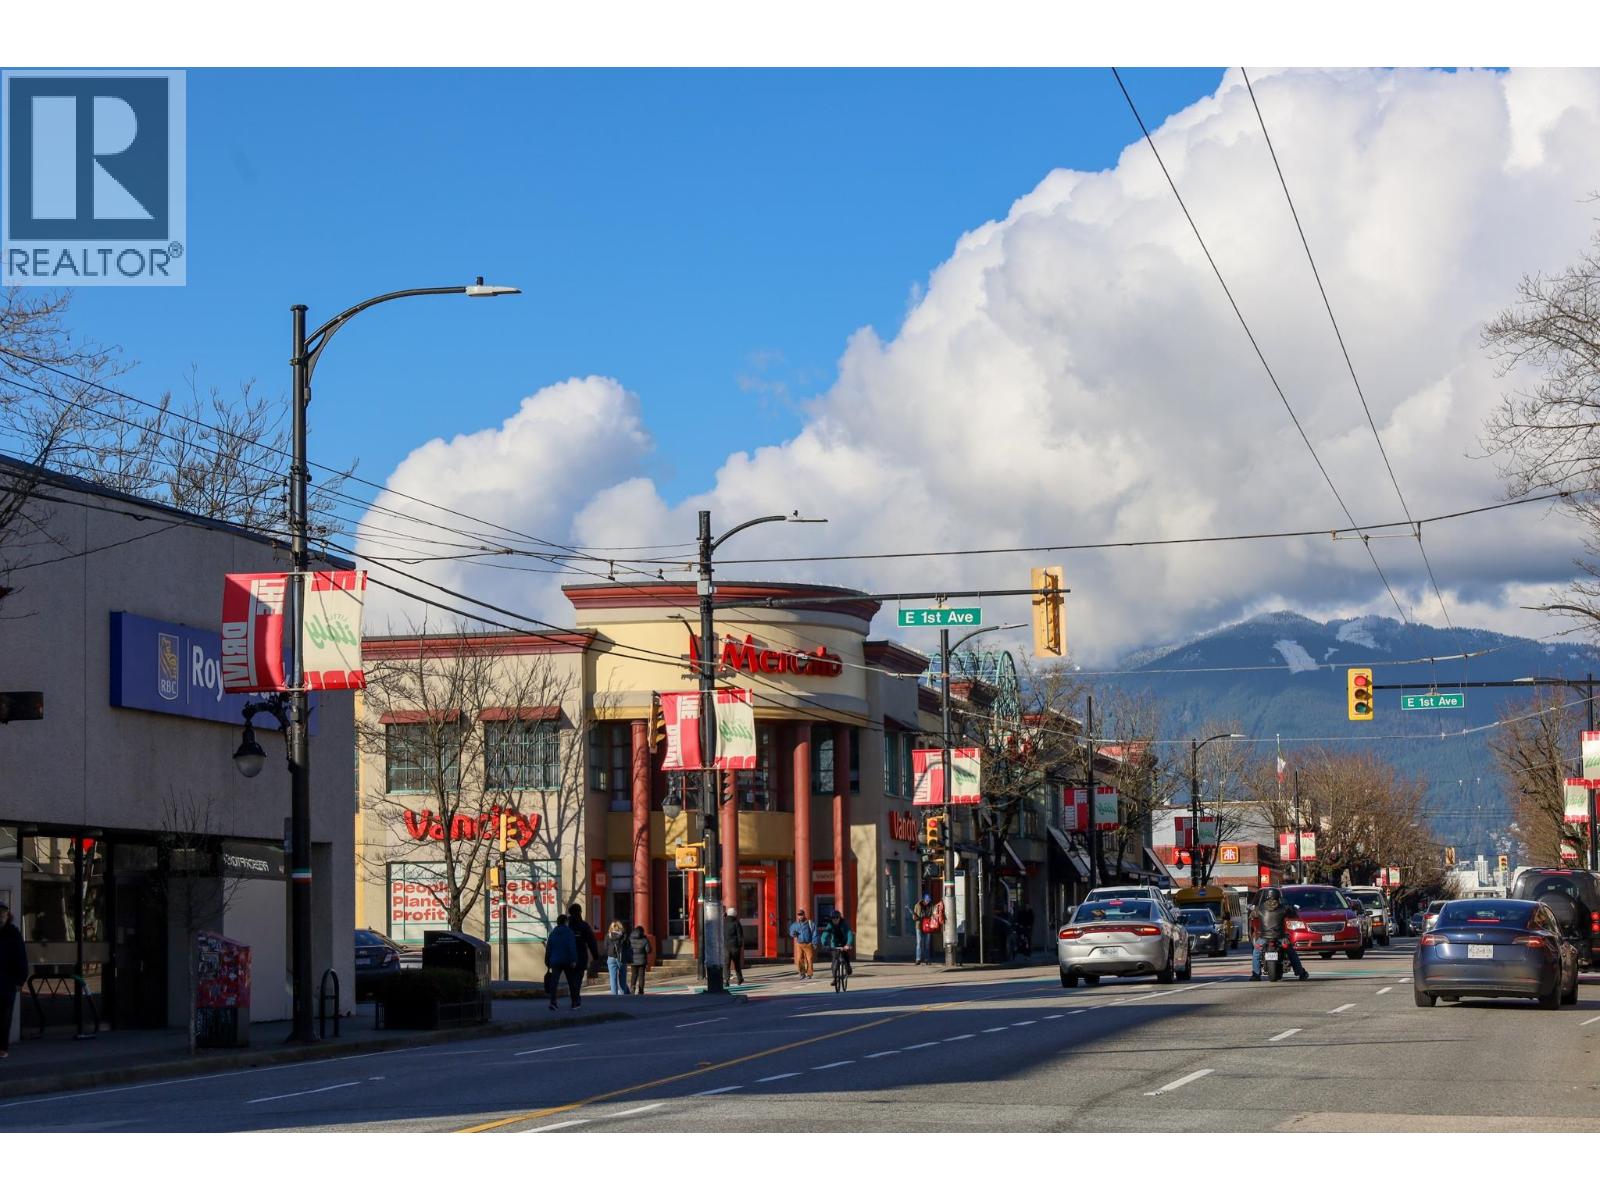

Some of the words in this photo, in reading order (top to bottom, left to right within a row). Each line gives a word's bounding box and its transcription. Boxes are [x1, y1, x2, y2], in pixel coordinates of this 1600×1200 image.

[905, 611, 915, 624] E
[921, 611, 942, 624] 1st
[947, 611, 974, 623] Ave
[192, 645, 224, 702] Roy
[160, 680, 177, 694] RBC
[1407, 697, 1415, 707] E
[1419, 697, 1434, 707] 1st
[1438, 696, 1458, 706] Ave
[403, 803, 541, 848] Vanciy
[392, 881, 449, 895] Peopl
[521, 879, 558, 891] look
[542, 892, 555, 904] it
